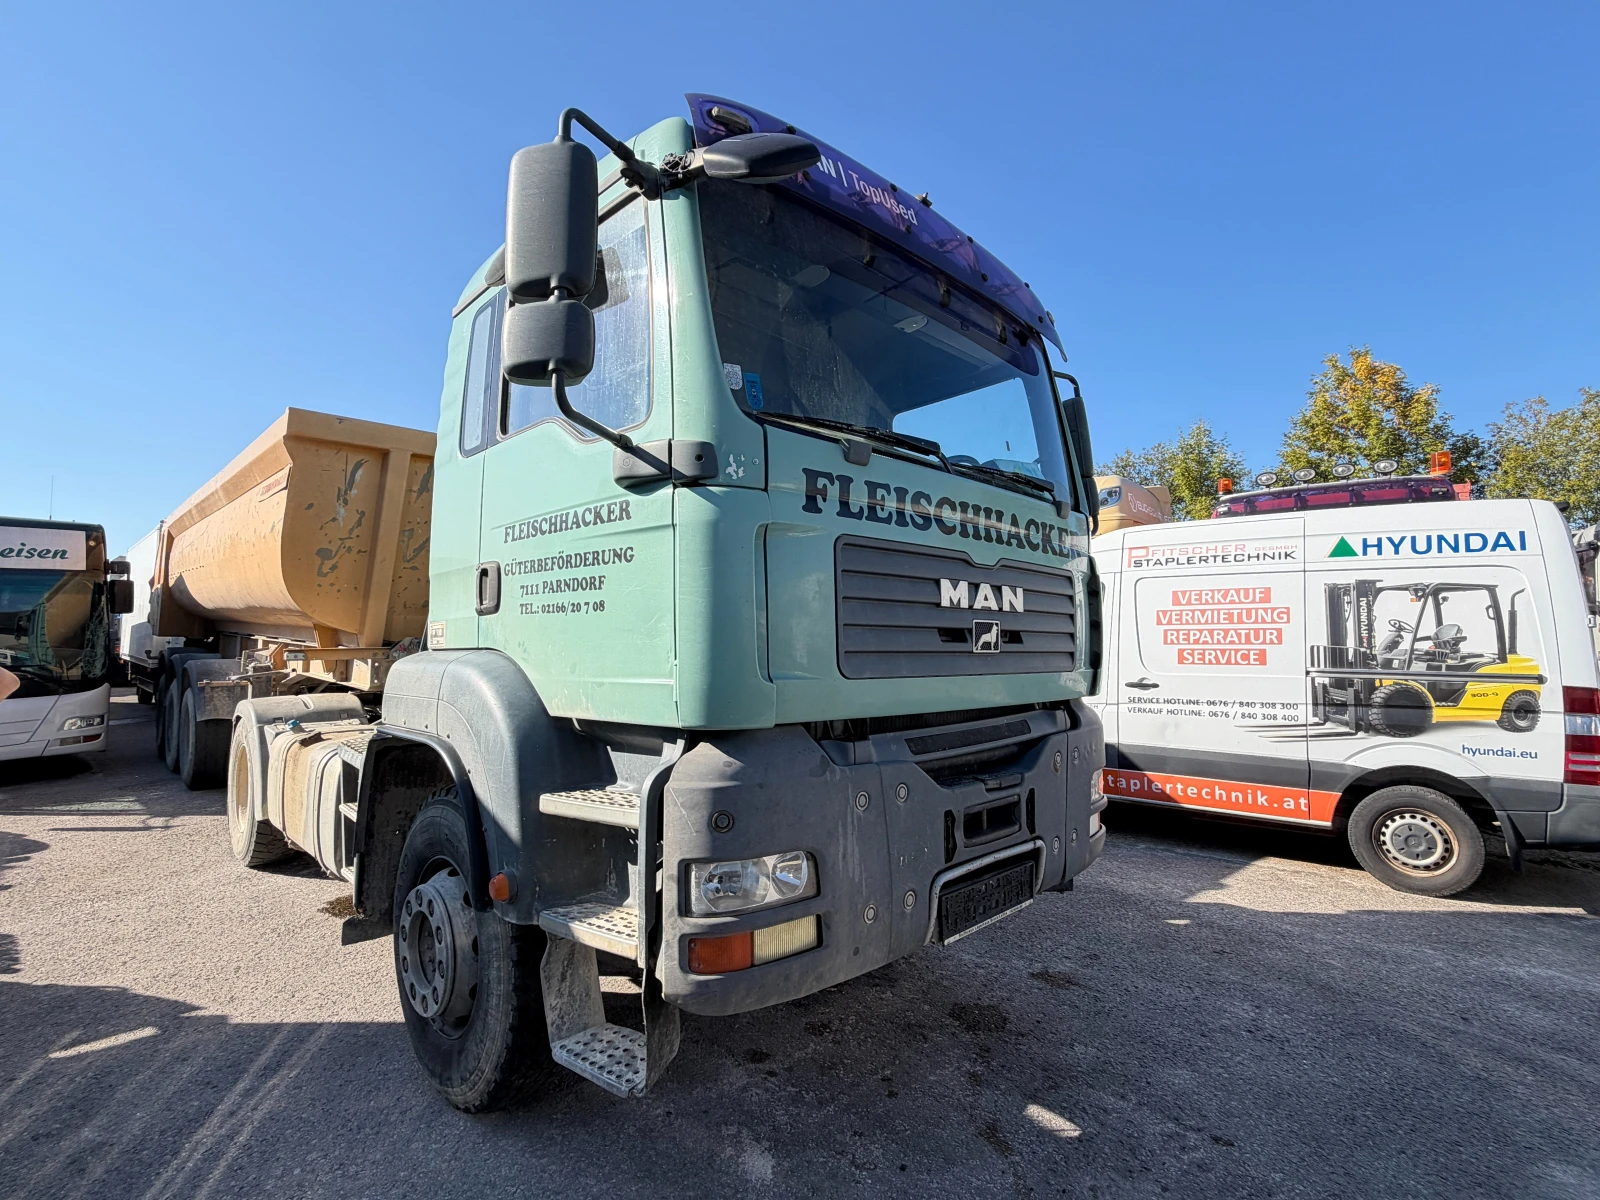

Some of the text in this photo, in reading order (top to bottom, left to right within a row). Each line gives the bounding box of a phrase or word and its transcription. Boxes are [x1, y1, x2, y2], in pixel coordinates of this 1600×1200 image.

[848, 170, 918, 226] TopUsed
[503, 499, 632, 544] FLEISCHHACKER
[0, 542, 69, 560] eisen
[1254, 544, 1298, 552] GESMBH
[1362, 530, 1527, 557] HYUNDAI
[504, 546, 635, 577] GÜTERBEFÖRDERUNG
[1132, 550, 1297, 568] STAPLERTECHNIK
[519, 575, 606, 598] 7111 PARNDORF
[939, 578, 1024, 613] MAN
[1177, 588, 1266, 605] VERKAUF
[519, 600, 606, 616] TEL.: 02166/20 7 08
[1158, 607, 1288, 625] VERMIETUNG
[1360, 597, 1368, 637] HYUNDAI
[1166, 629, 1279, 644] REPARATUR
[1182, 650, 1260, 665] SERVICE
[1127, 696, 1161, 704] SERVICE
[1163, 697, 1204, 706] HOTLINE:
[1206, 699, 1229, 707] 0676
[1231, 700, 1236, 709] /
[1238, 701, 1256, 709] 840
[1279, 702, 1299, 710] 300
[1127, 706, 1299, 722] VERKAUF HOTLINE: 0676 / 840 308 400
[1461, 744, 1538, 759] hyundai.eu
[1103, 773, 1308, 811] taplertechnik.at
